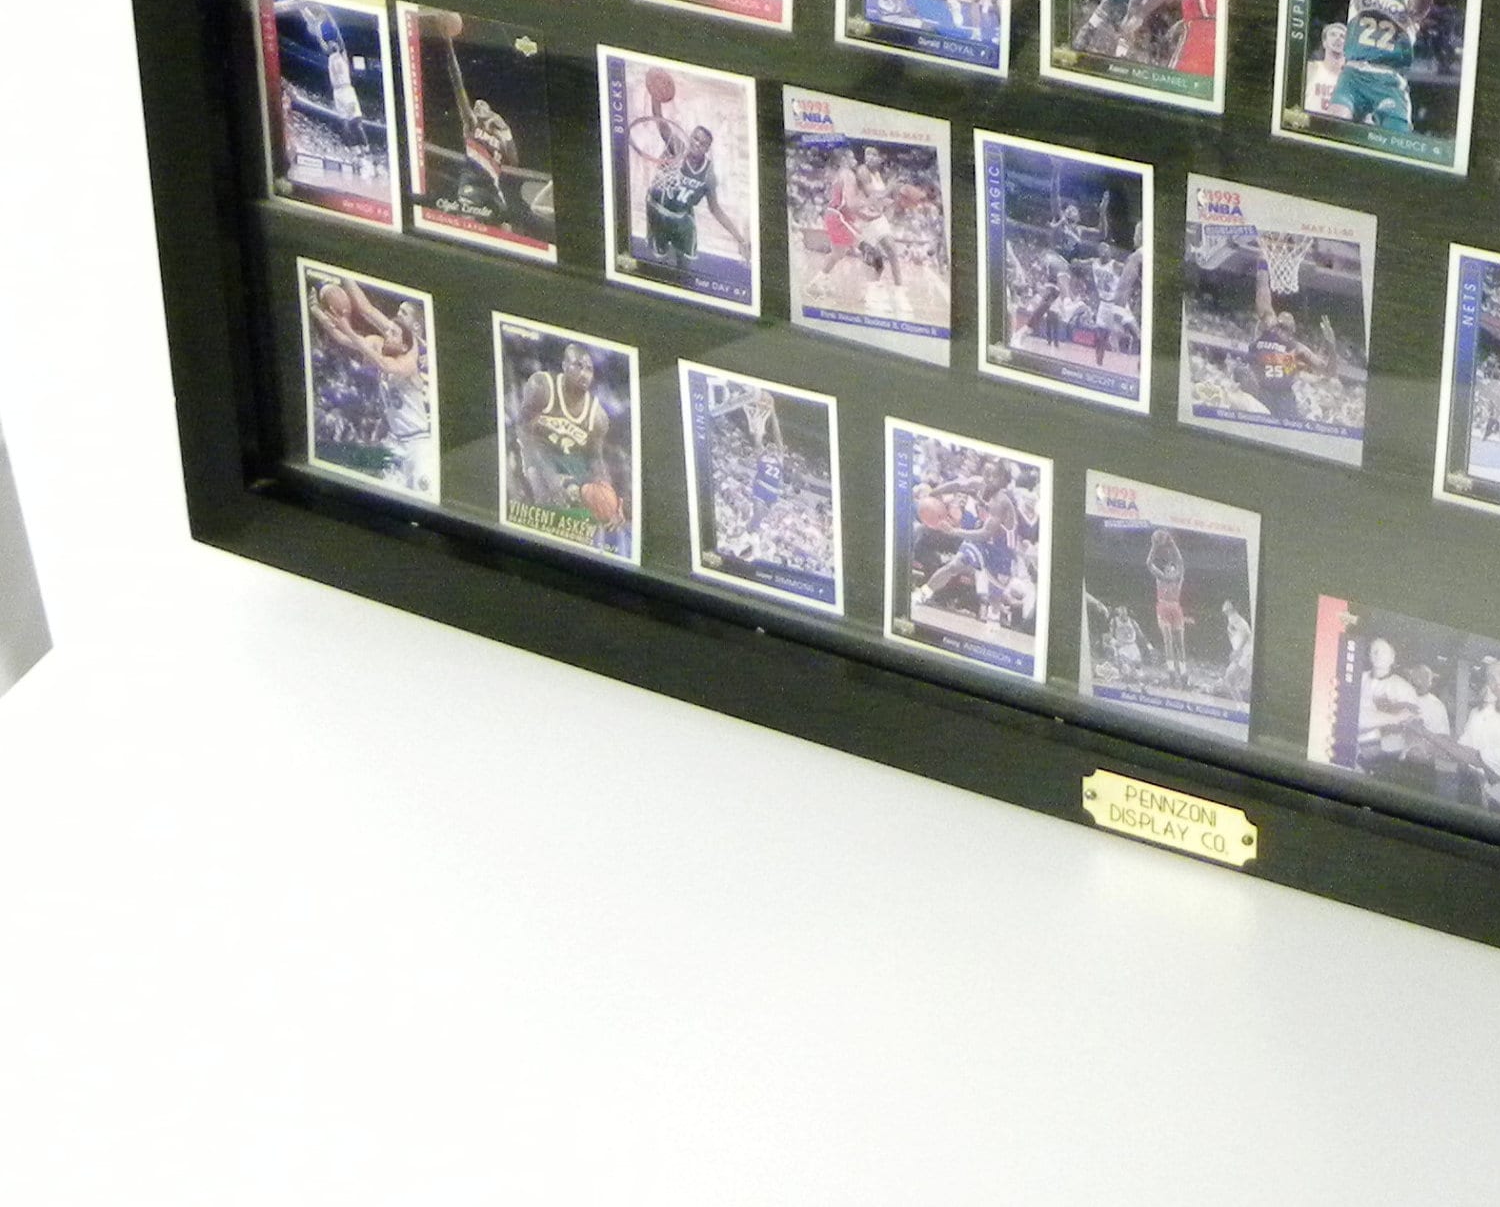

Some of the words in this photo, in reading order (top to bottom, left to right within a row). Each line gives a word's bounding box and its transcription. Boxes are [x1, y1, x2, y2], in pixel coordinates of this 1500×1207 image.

[1357, 16, 1397, 51] 22
[612, 80, 625, 135] BUCKS
[802, 111, 834, 125] NBA
[988, 165, 1001, 226] MAGIC
[1207, 189, 1242, 206] 1993
[1207, 202, 1244, 217] NBA
[711, 282, 730, 293] DAY
[1462, 282, 1478, 327] NETS
[1264, 364, 1285, 379] 25
[764, 464, 782, 480] 22
[897, 451, 909, 491] NETS
[509, 499, 557, 529] VINCENT
[557, 513, 598, 540] ASKEW
[1106, 496, 1139, 512] NBA
[1125, 784, 1217, 827] PENNZONI
[1109, 803, 1189, 841] DISPLAY
[1201, 831, 1229, 855] CO.
